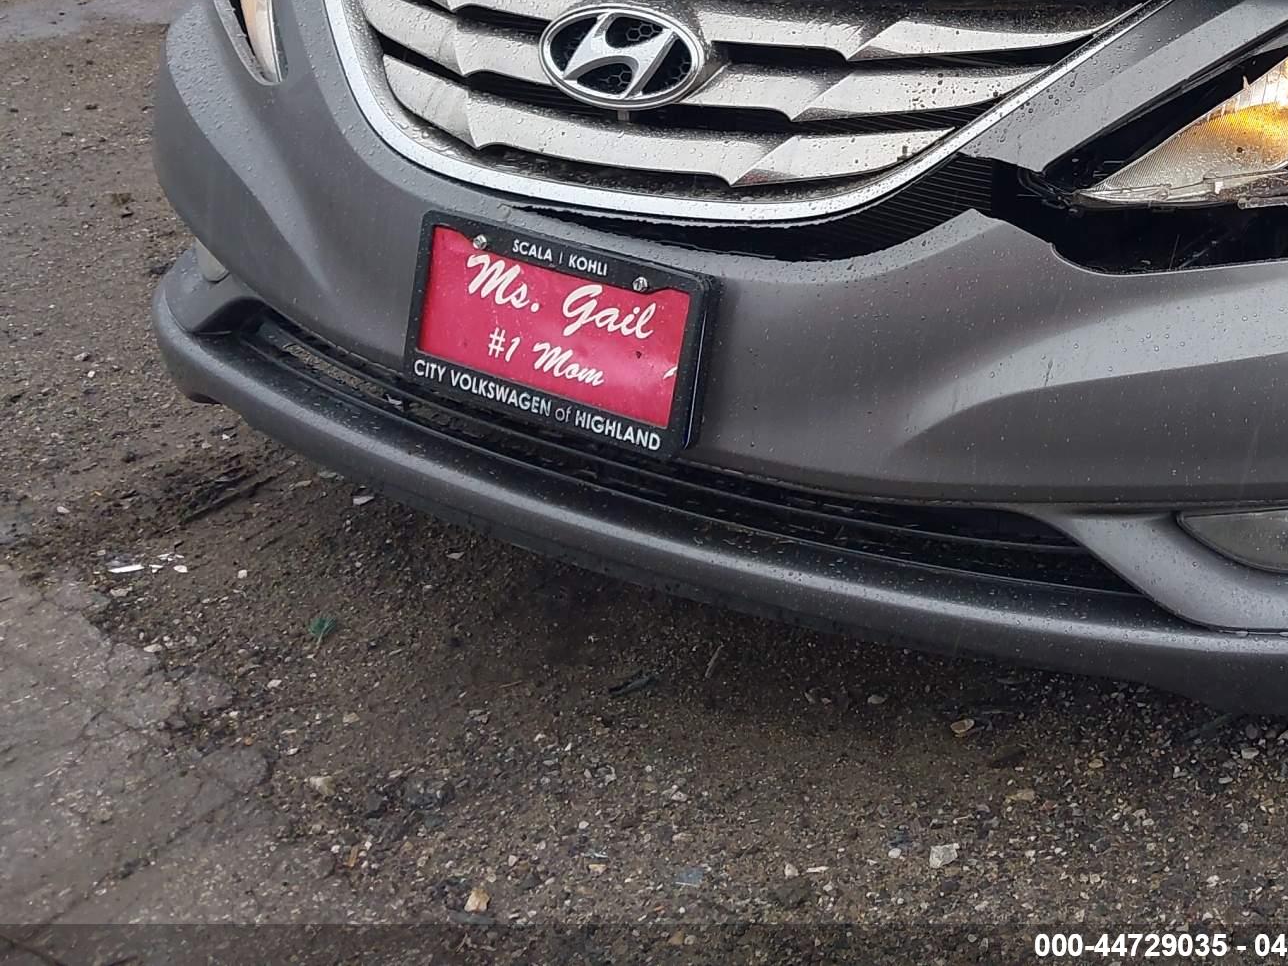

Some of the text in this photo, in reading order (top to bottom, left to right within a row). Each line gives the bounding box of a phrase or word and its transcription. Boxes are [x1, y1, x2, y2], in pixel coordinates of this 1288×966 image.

[512, 239, 553, 262] SCALA
[568, 253, 608, 276] KOHLI
[466, 253, 657, 340] Ms. Gail
[488, 327, 604, 387] #1 Mom
[413, 359, 661, 452] CITY VOLKSWAGEN of HIGHLAND
